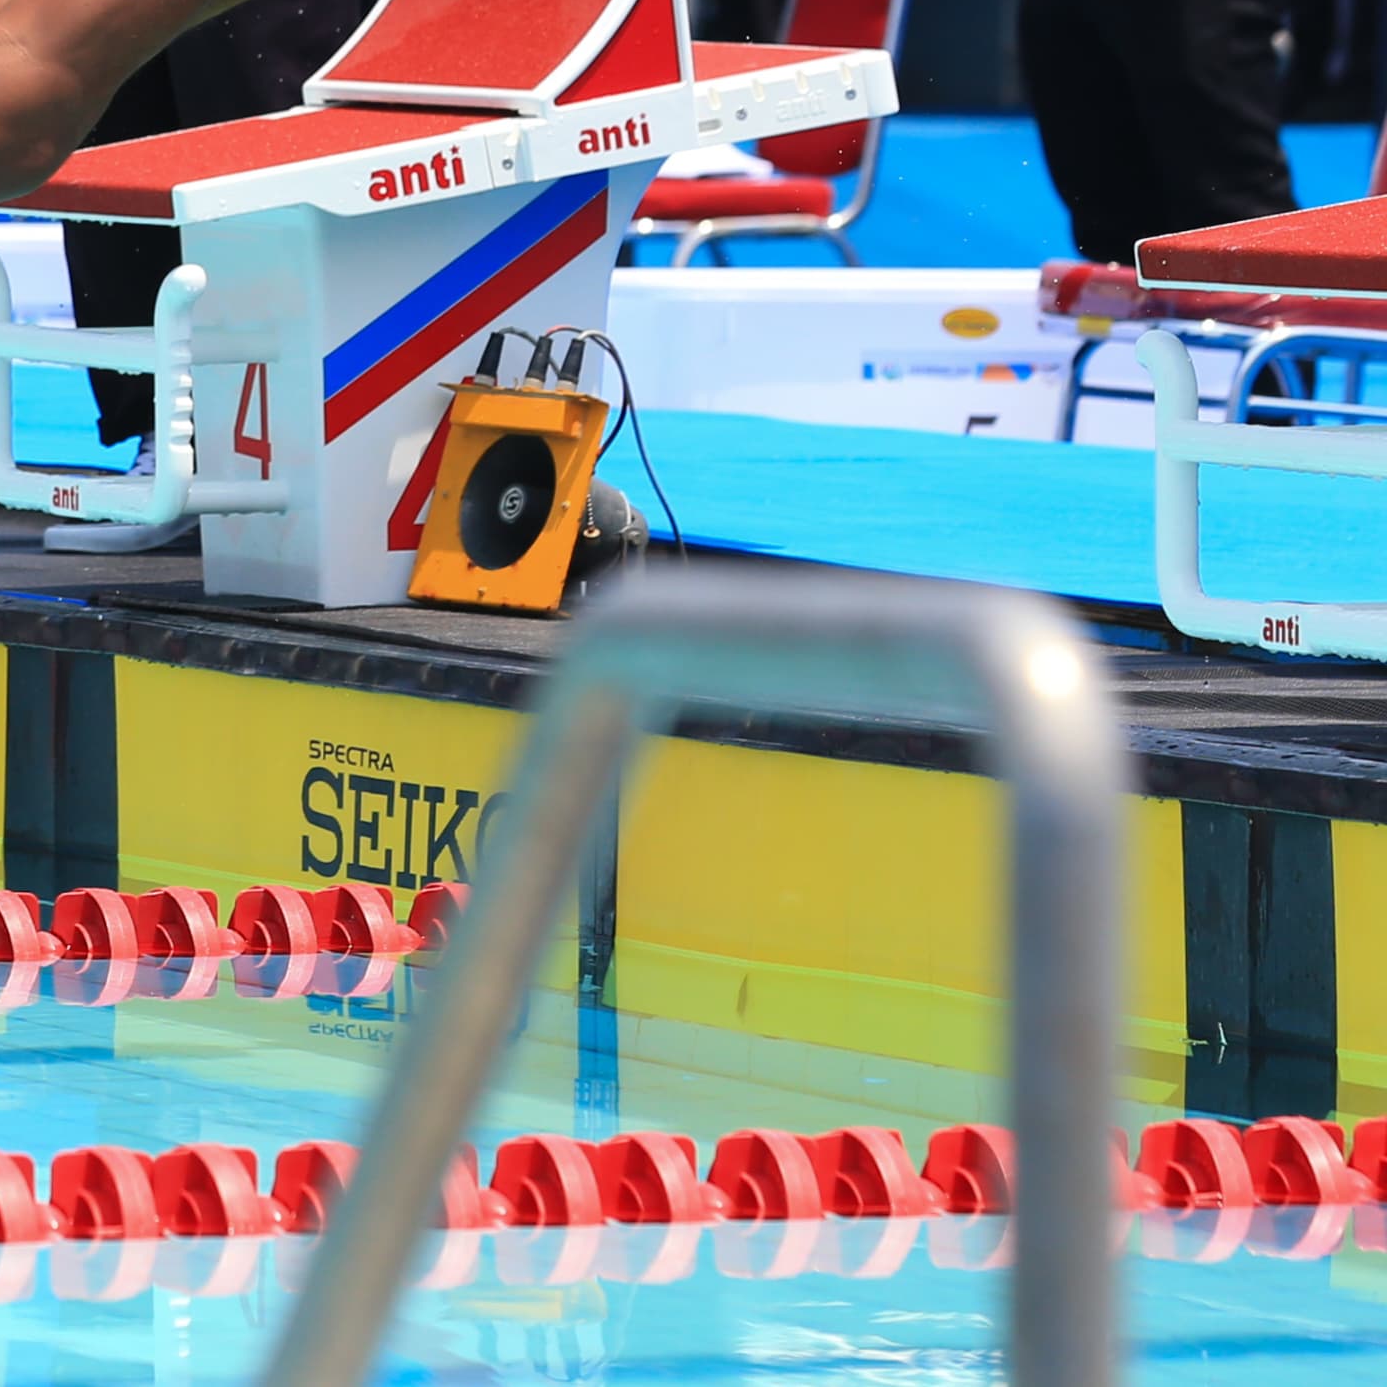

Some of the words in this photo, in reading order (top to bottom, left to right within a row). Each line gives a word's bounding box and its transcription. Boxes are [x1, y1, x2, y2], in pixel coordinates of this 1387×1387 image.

[578, 113, 651, 155] anti
[368, 145, 467, 202] anti
[233, 363, 271, 480] 4
[52, 485, 80, 511] anti
[1262, 614, 1301, 646] anti
[309, 739, 395, 773] SPECTRA
